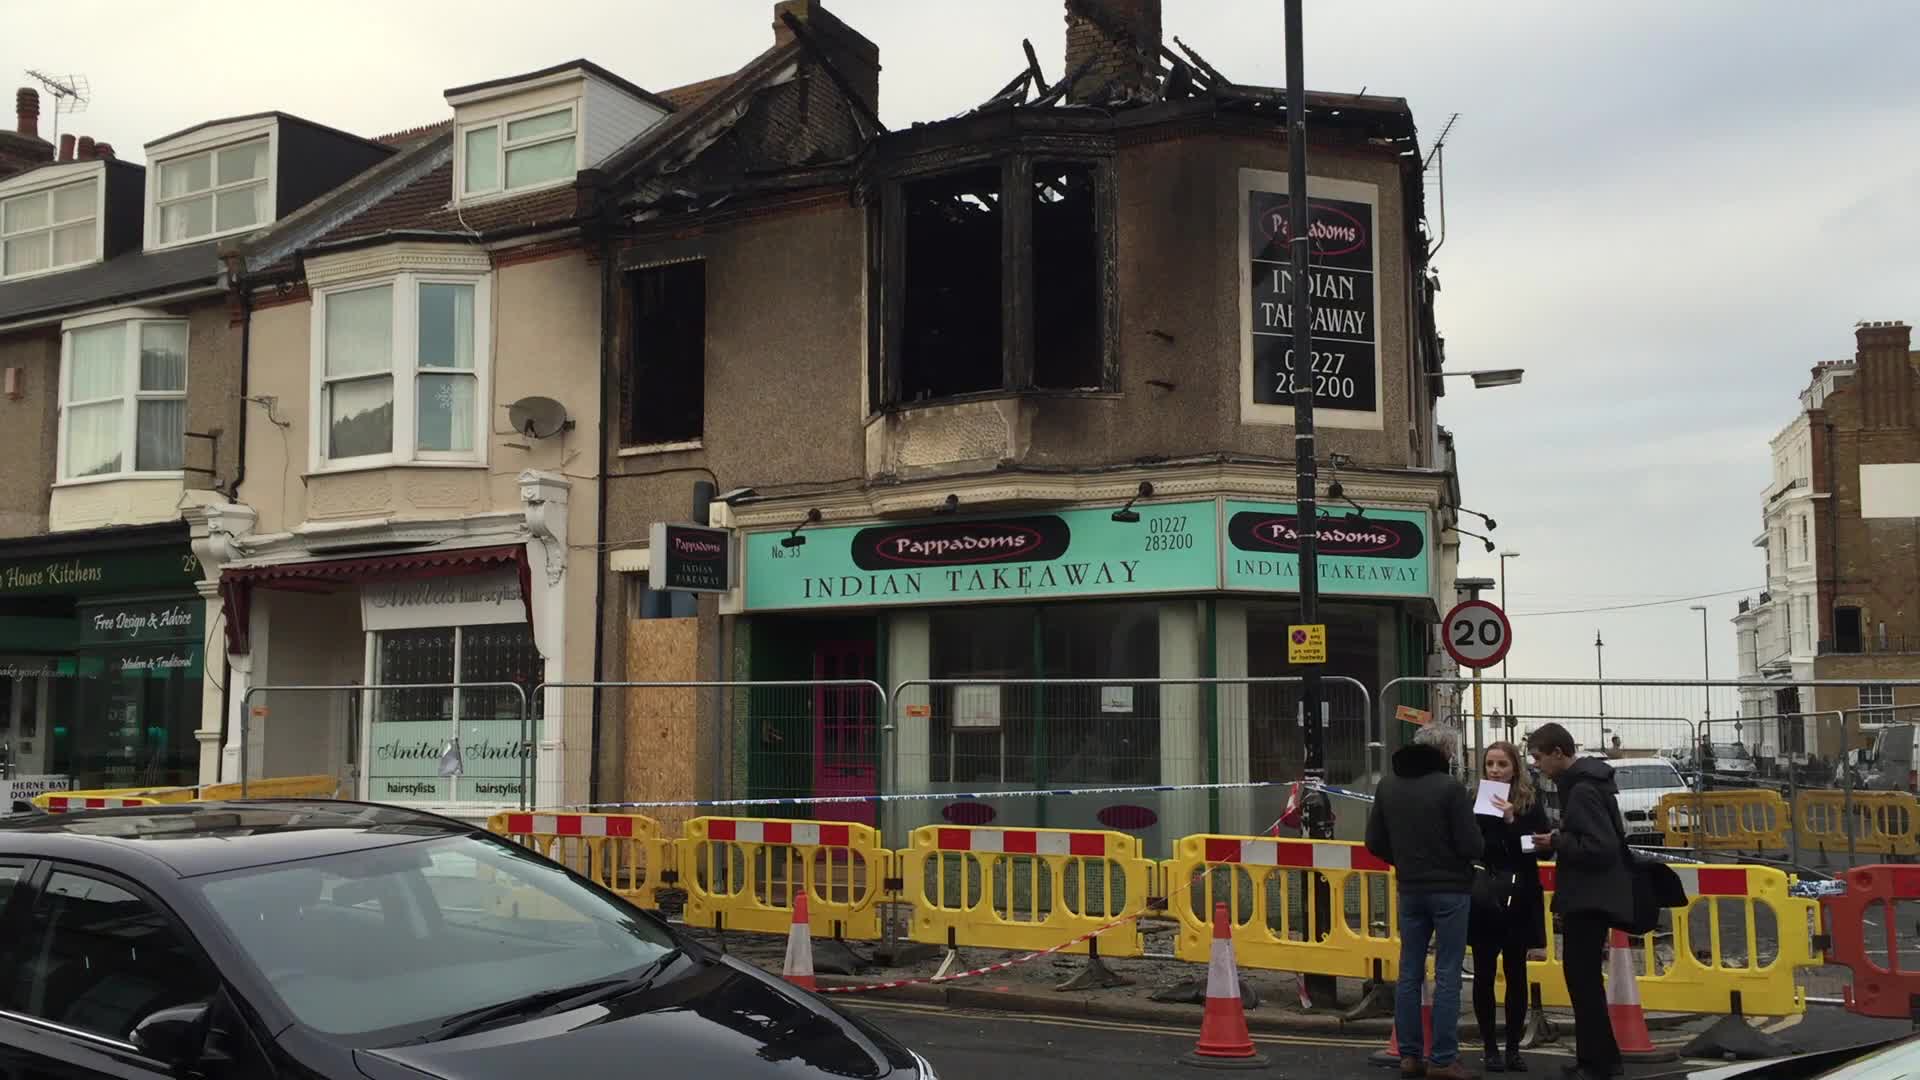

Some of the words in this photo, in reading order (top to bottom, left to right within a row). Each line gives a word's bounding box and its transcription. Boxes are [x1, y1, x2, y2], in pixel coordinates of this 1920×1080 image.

[1272, 213, 1356, 241] Paadoms
[1285, 349, 1345, 374] 0227
[1275, 372, 1354, 398] 28200
[1150, 516, 1187, 534] 01227
[896, 534, 1025, 554] Pappadoms
[1145, 533, 1193, 551] 283200
[182, 553, 197, 572] 29
[1236, 559, 1301, 577] INDIA
[1319, 563, 1420, 582] TAKEAWAY
[6, 566, 43, 588] House
[46, 560, 102, 584] Kitchens
[803, 573, 921, 598] INDIAN
[946, 560, 1140, 592] TAKEAWAY
[94, 613, 114, 630] Free
[116, 612, 145, 637] Design
[147, 612, 158, 630] &
[160, 606, 192, 627] Advice
[1453, 619, 1501, 646] 20
[377, 738, 444, 760] Anita'
[12, 781, 45, 790] HERNE
[48, 780, 68, 789] BAY
[387, 782, 435, 796] hairstylists
[475, 782, 526, 796] hairstylist
